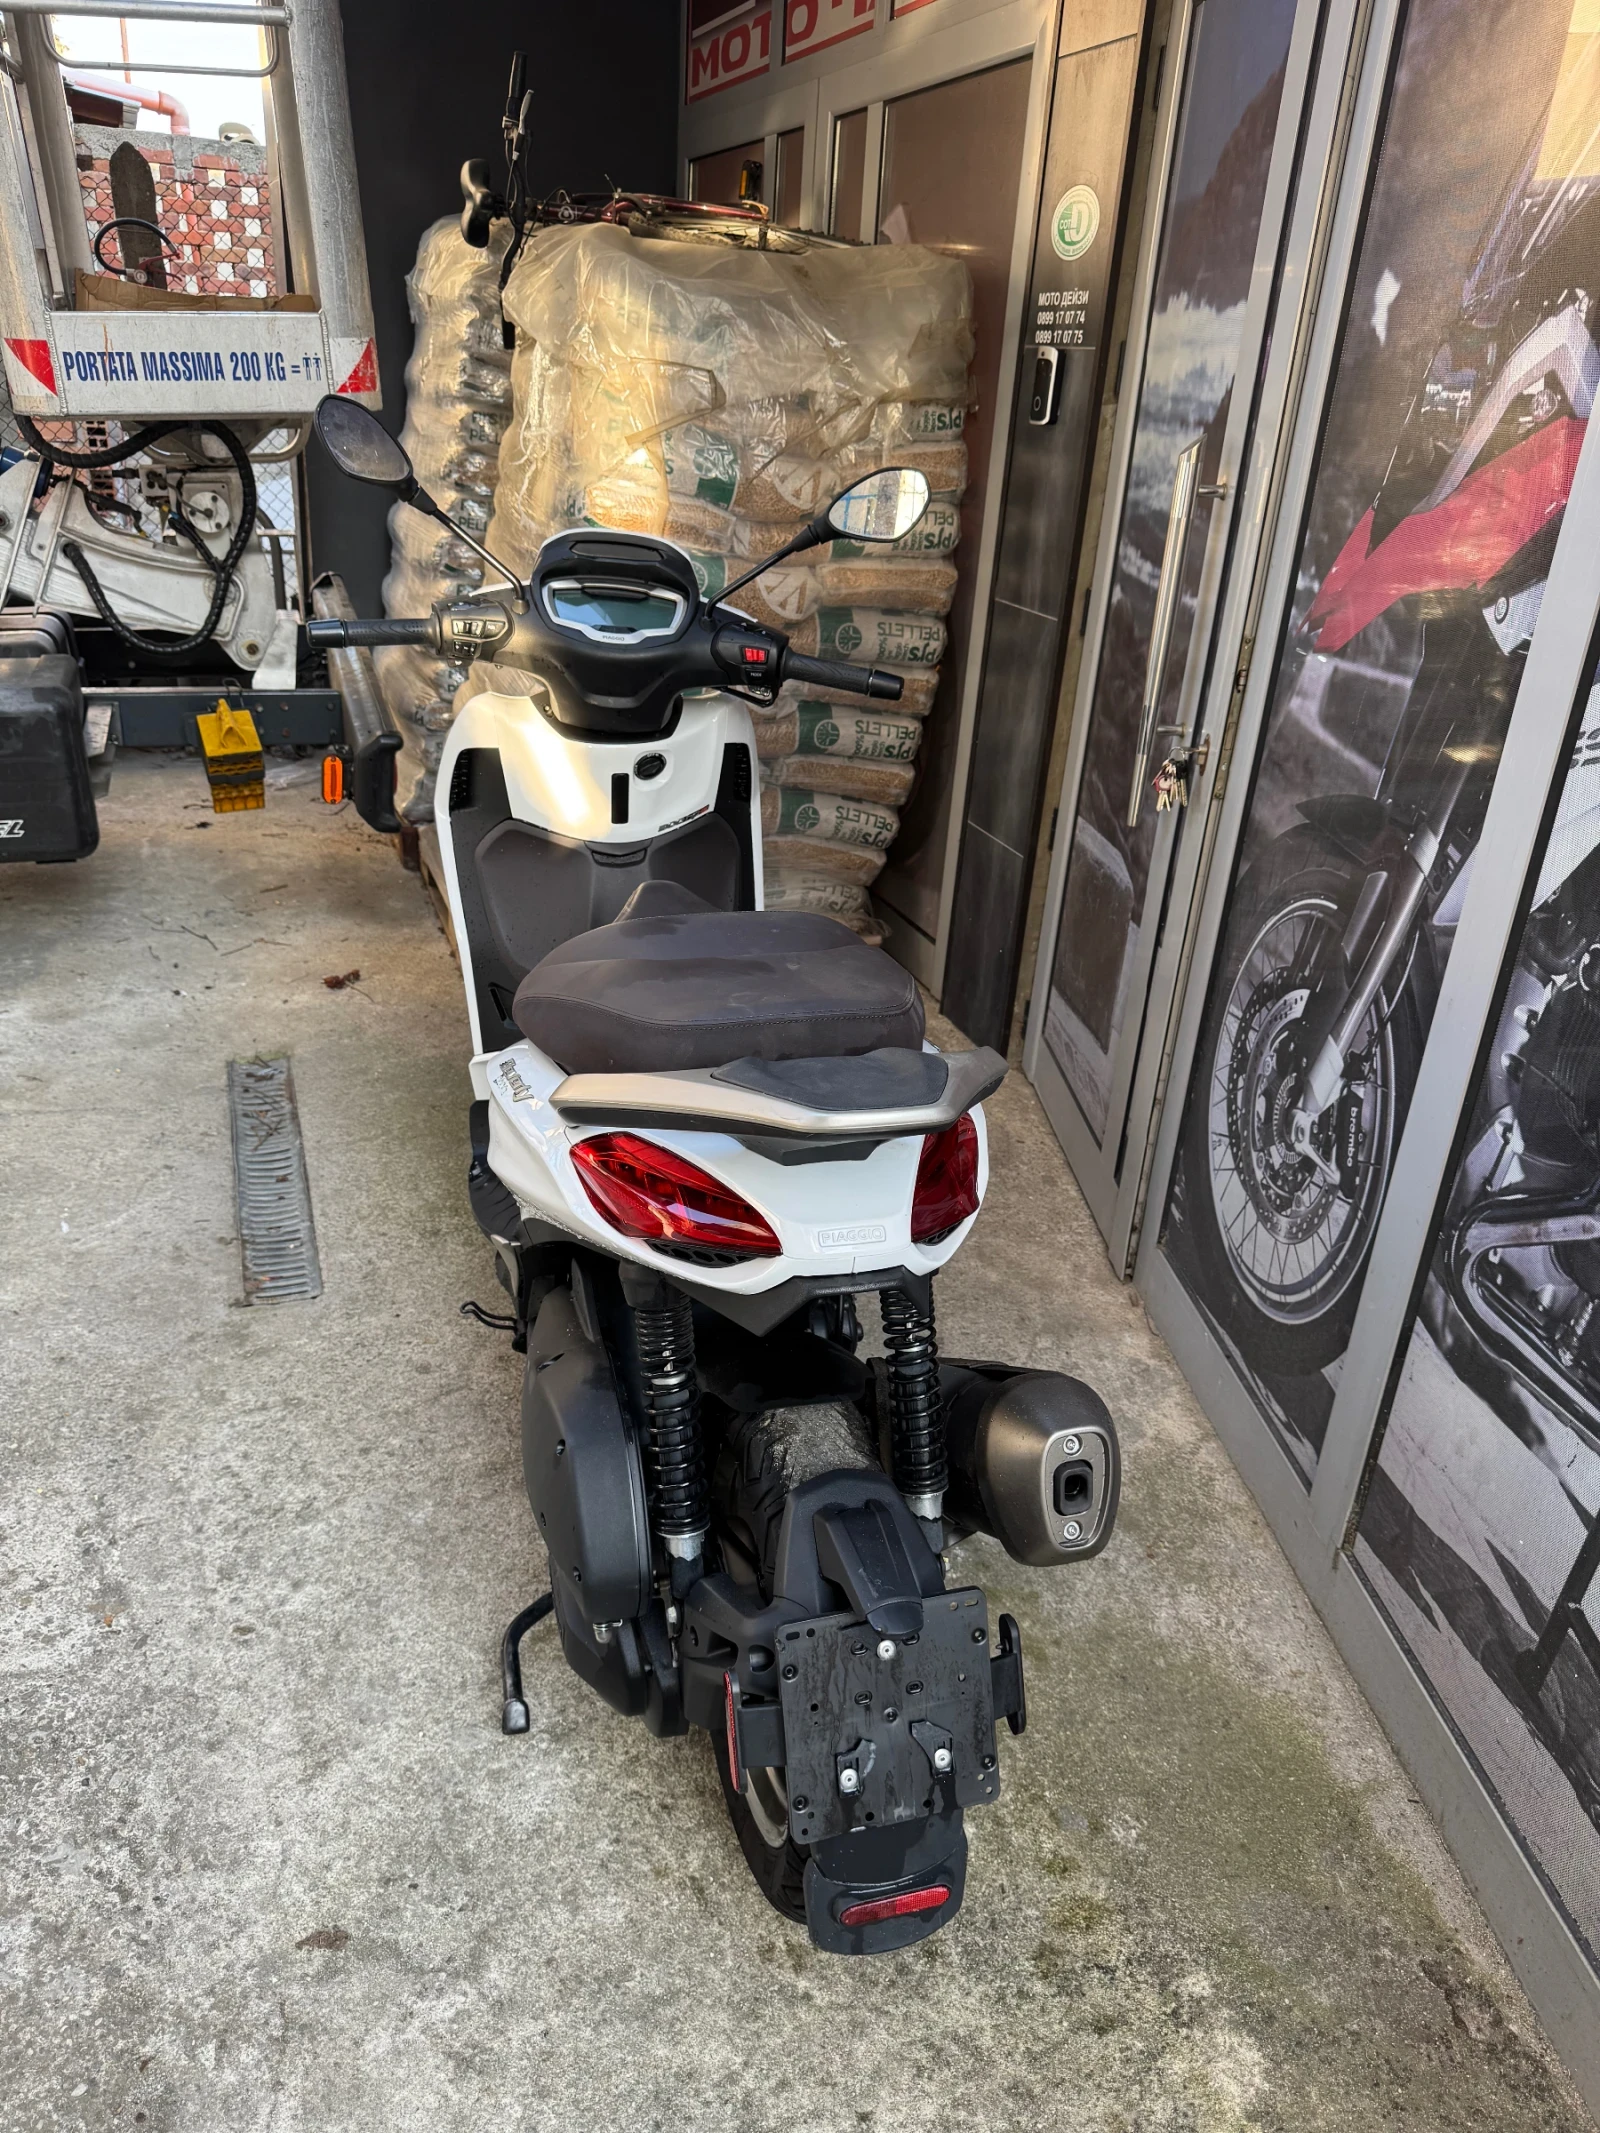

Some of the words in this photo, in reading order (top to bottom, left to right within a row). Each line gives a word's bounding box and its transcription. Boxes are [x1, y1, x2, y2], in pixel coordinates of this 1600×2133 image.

[1038, 292, 1061, 306] МОТО
[1060, 287, 1089, 308] ДЕЙЗИ
[1036, 310, 1054, 325] 0899
[1055, 310, 1064, 325] 17
[1065, 310, 1075, 325] 07
[1076, 309, 1086, 324] 74
[1034, 329, 1052, 344] 0899
[1053, 329, 1062, 344] 17
[1062, 329, 1072, 344] 07
[1073, 329, 1083, 344] 75
[62, 351, 138, 381] PORTATA
[140, 351, 225, 382] MASSIMA
[230, 351, 262, 381] 200
[265, 351, 287, 381] KG
[877, 621, 940, 642] PELLETS
[855, 719, 918, 740] PELLETS
[835, 805, 894, 833] PELLETS
[1346, 1107, 1359, 1168] brembo
[821, 1228, 884, 1244] PIAGGIO
